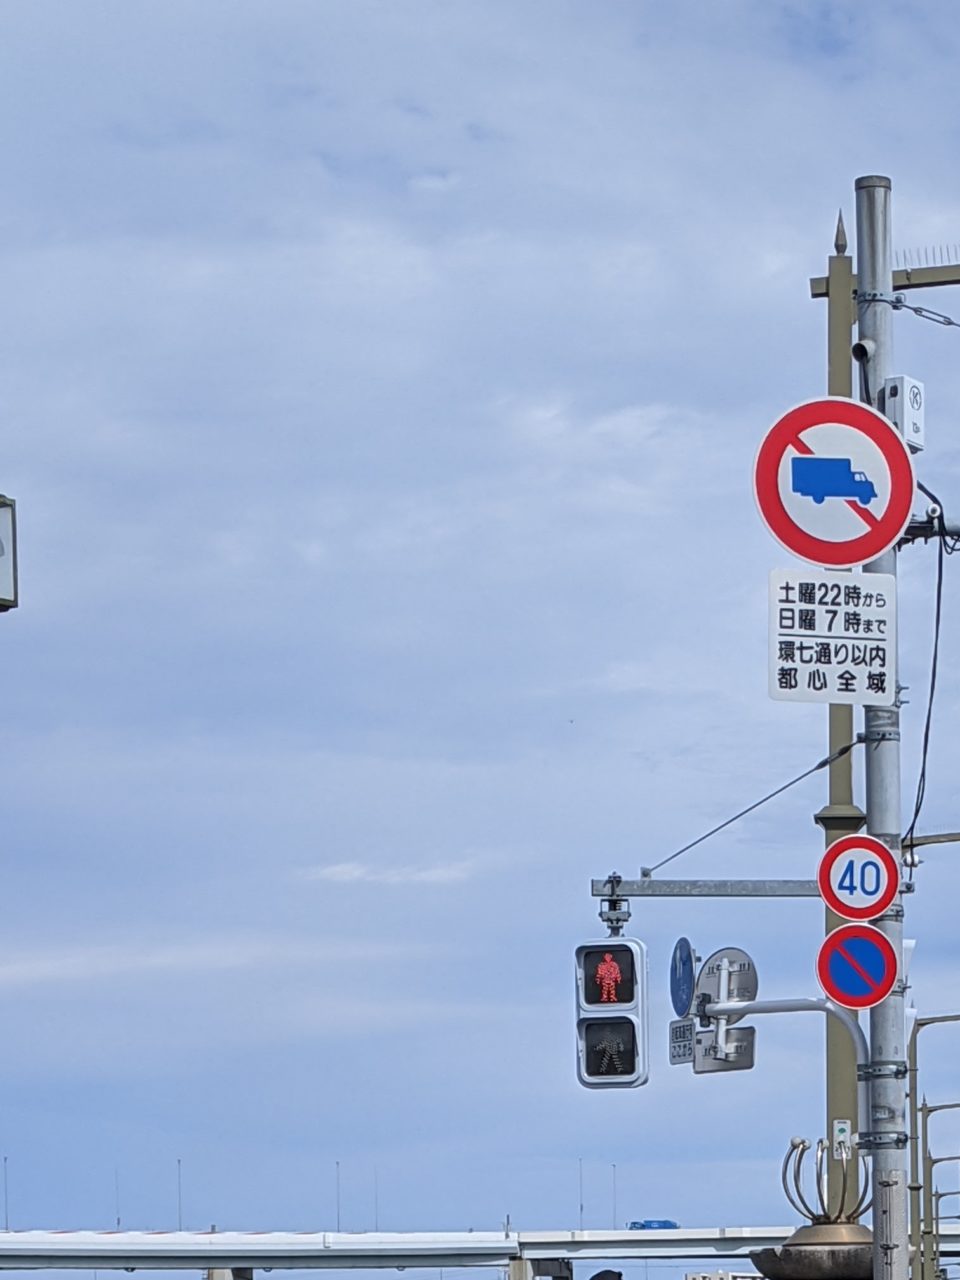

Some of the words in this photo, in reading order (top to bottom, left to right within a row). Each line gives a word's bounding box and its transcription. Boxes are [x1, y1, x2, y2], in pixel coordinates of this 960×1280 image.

[778, 581, 887, 608] 土曜22時から
[778, 641, 886, 668] 環七通り以内
[777, 666, 887, 694] 都心全域
[838, 860, 881, 896] 40
